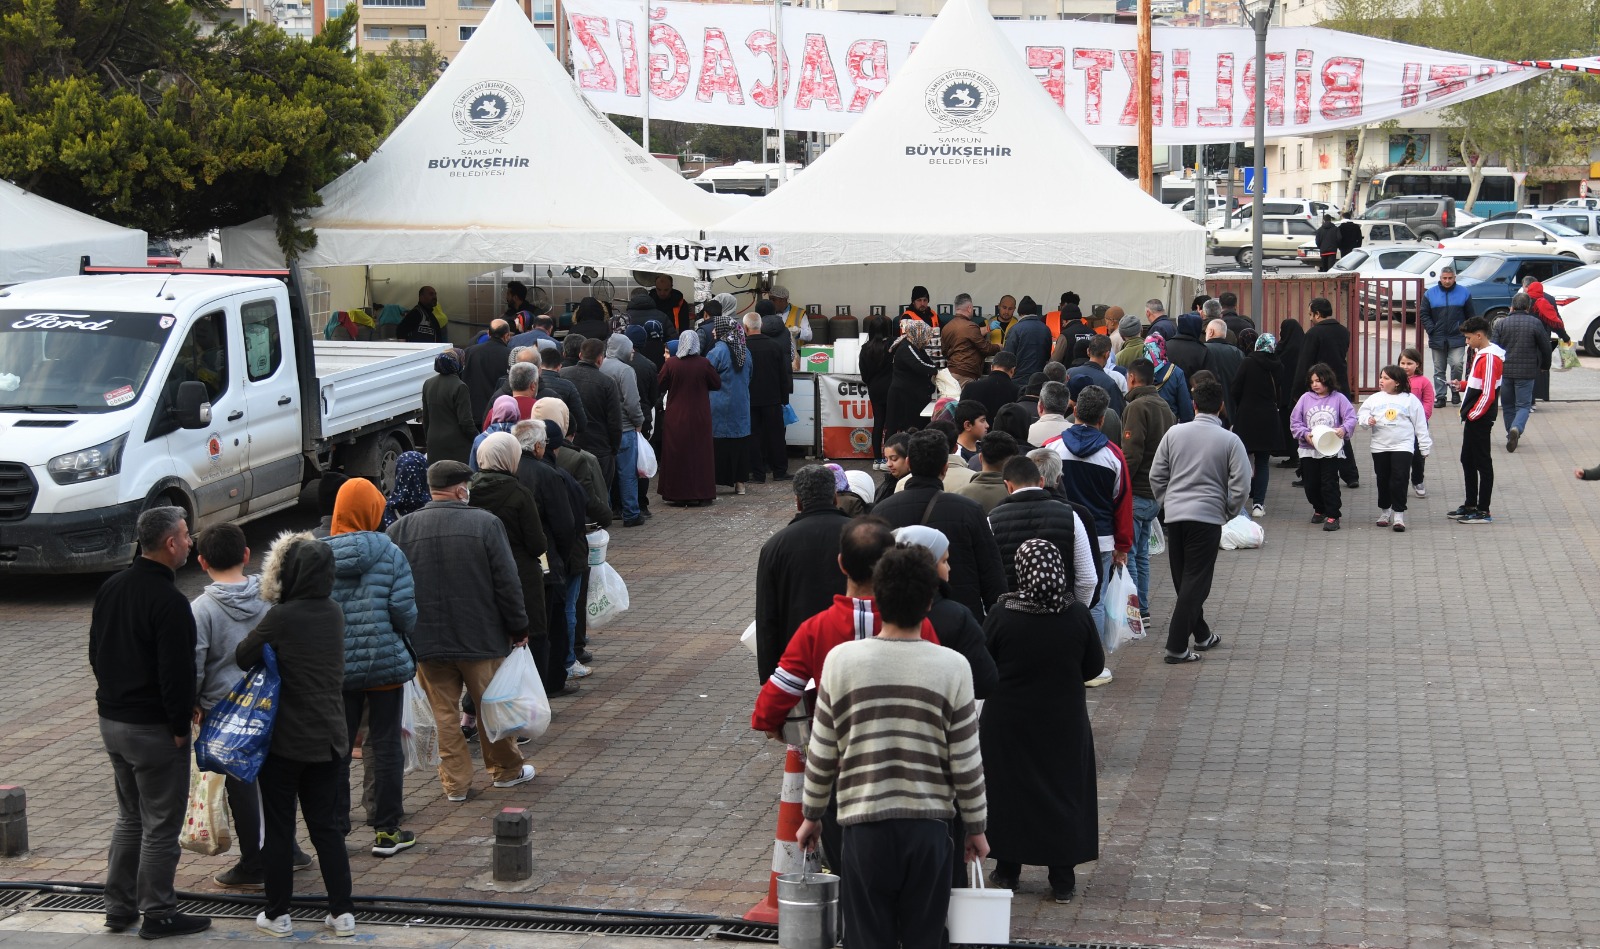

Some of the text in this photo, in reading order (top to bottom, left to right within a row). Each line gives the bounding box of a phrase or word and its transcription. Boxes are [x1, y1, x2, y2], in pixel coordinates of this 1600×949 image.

[461, 148, 502, 156] SAMSUN
[905, 144, 1012, 157] BÜYÜKŞEHİR
[428, 156, 530, 169] BÜYÜKŞEHİR
[449, 169, 506, 178] BELEDİYESİ
[656, 244, 751, 262] MUTFAK
[12, 312, 114, 331] Ford
[838, 382, 869, 399] GEÇ
